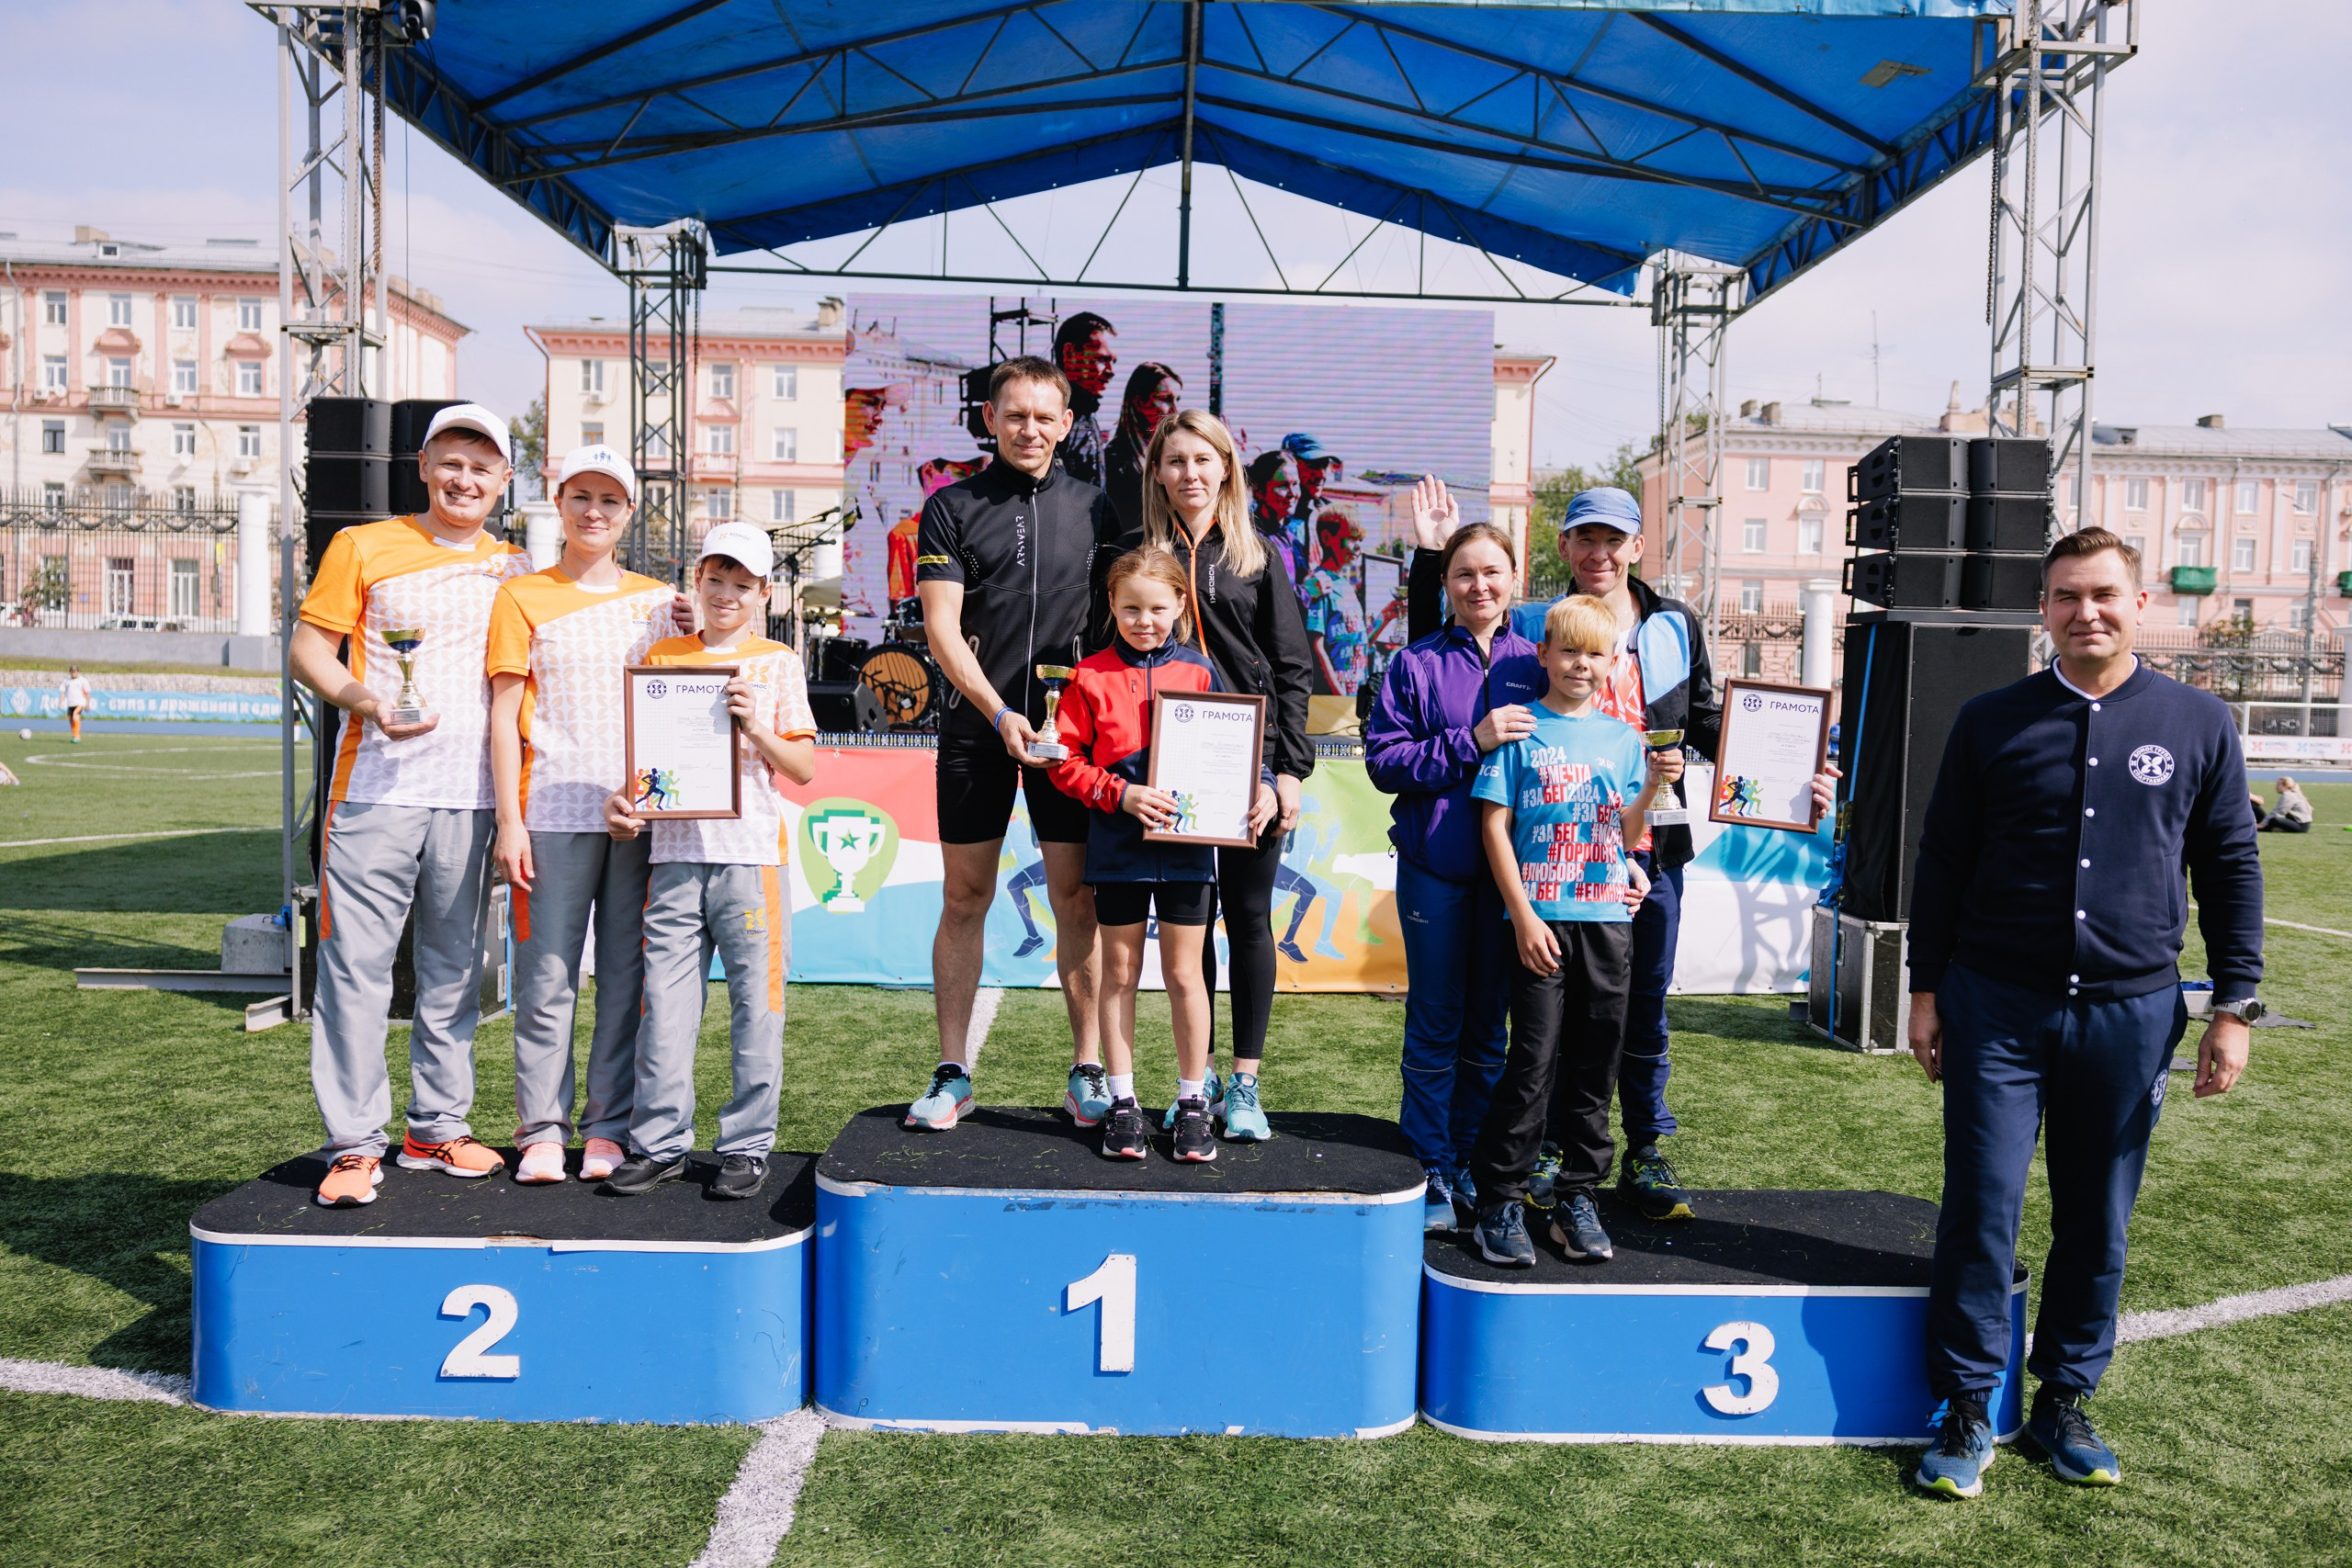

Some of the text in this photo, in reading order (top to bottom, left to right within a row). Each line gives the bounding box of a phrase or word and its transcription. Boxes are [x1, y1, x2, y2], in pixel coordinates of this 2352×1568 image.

[1208, 564, 1216, 604] NORDSKI
[1202, 710, 1253, 722] ГРАМОТА
[1770, 701, 1820, 715] ГРАМОТА
[1530, 746, 1567, 768] 2024
[1538, 764, 1591, 785] #МЕЧТА
[1522, 783, 1600, 808] #ЗАБЕГ2024
[1547, 842, 1618, 863] #ГОРДОСТЬ
[1521, 863, 1585, 882] #ЛЮБОВЬ
[1606, 863, 1629, 884] 2024
[1067, 1254, 1137, 1373] 1
[438, 1283, 521, 1379] 2
[1702, 1321, 1781, 1416] 3
